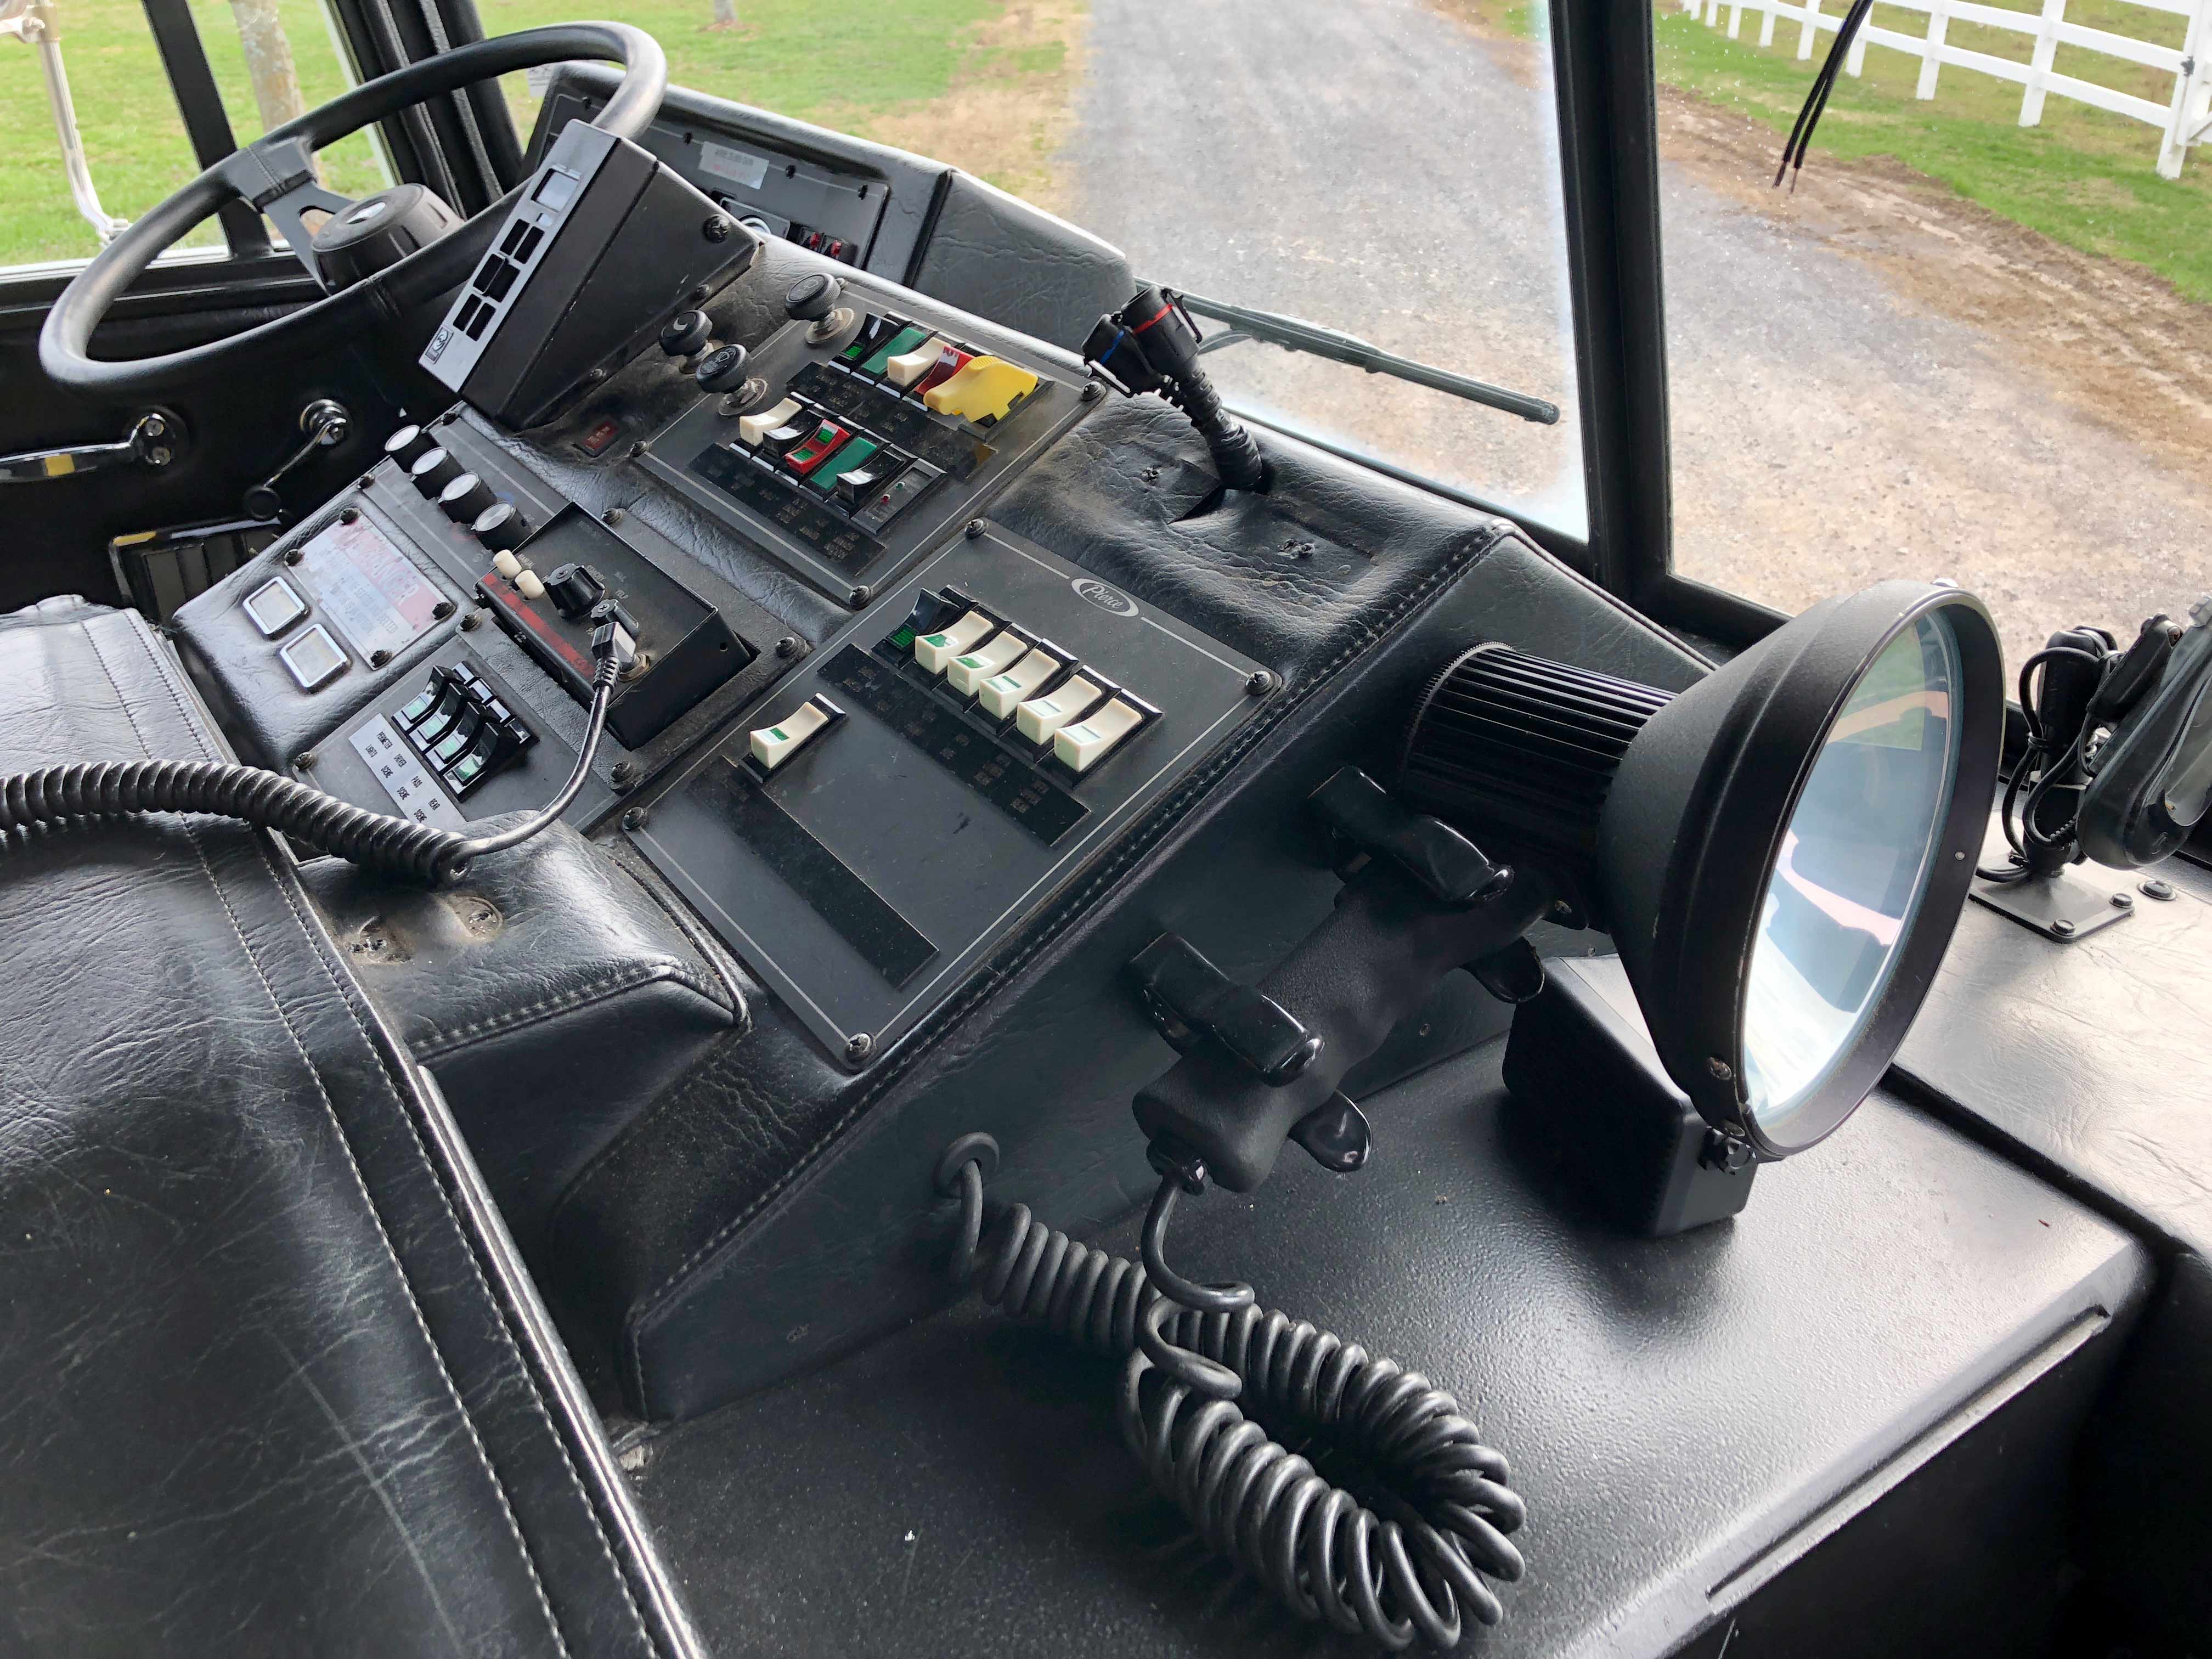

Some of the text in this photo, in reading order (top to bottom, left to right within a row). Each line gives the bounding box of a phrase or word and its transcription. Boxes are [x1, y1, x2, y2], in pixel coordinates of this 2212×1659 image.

[517, 553, 535, 568] MANUAL
[614, 589, 628, 600] YELP
[1082, 584, 1124, 609] Pierce
[376, 731, 393, 750] PERIMETER
[365, 744, 377, 758] LIGHTS
[393, 753, 407, 768] DRIVER
[381, 765, 393, 778] SCENE
[410, 776, 422, 788] PASS
[397, 786, 410, 800] SCENE
[428, 798, 441, 810] REAR
[414, 809, 427, 823] SCENE
